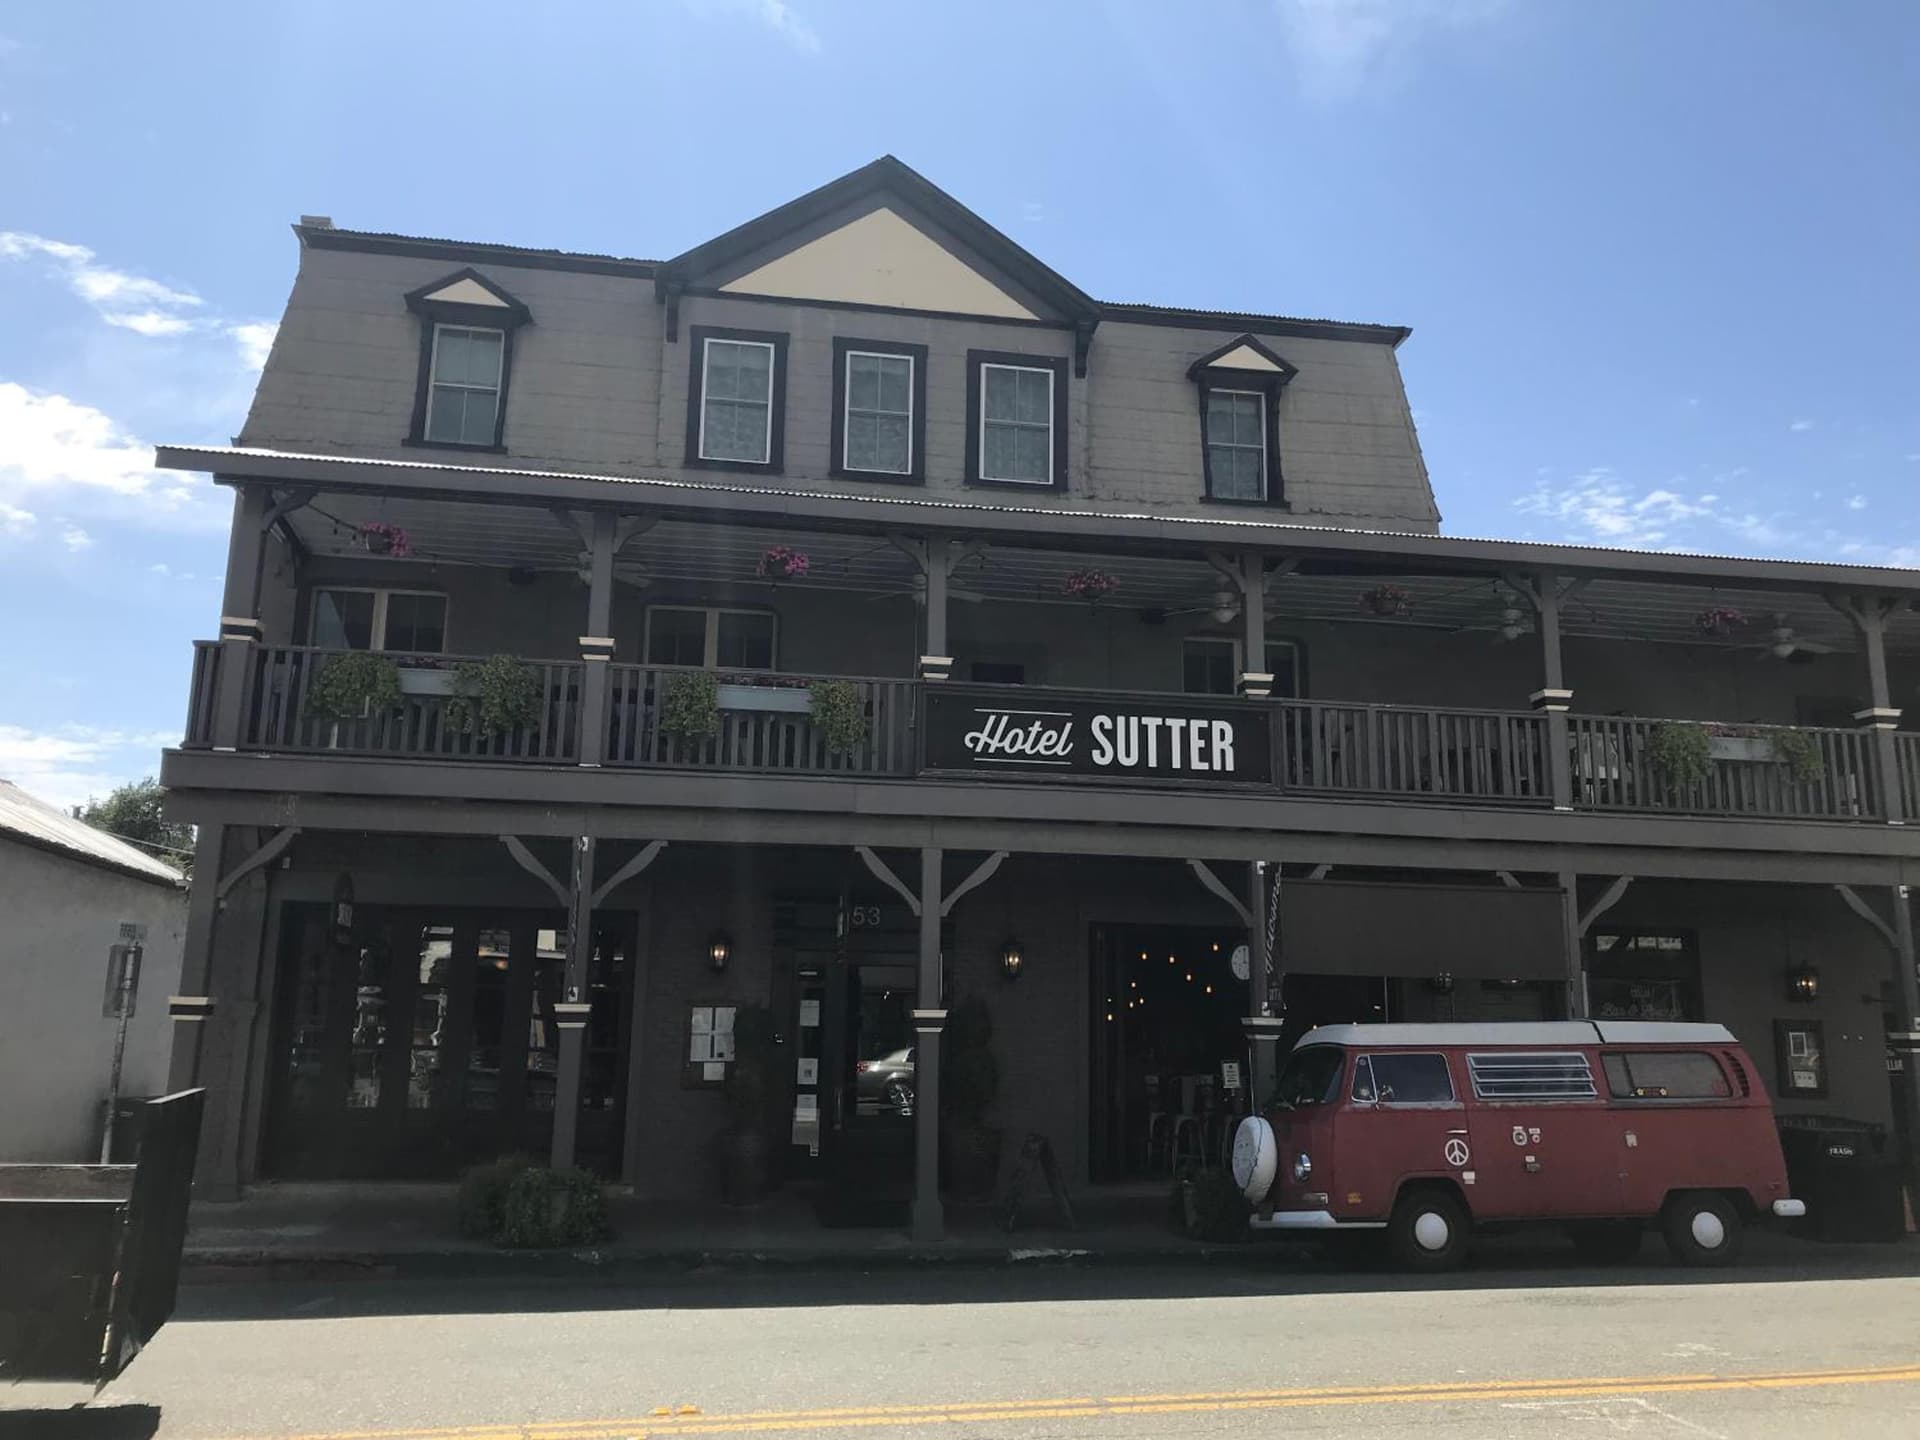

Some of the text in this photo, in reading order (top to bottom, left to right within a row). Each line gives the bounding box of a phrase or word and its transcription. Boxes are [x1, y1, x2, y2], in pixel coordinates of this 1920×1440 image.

[963, 714, 1235, 772] Hotel SUTTER
[852, 905, 881, 926] 53
